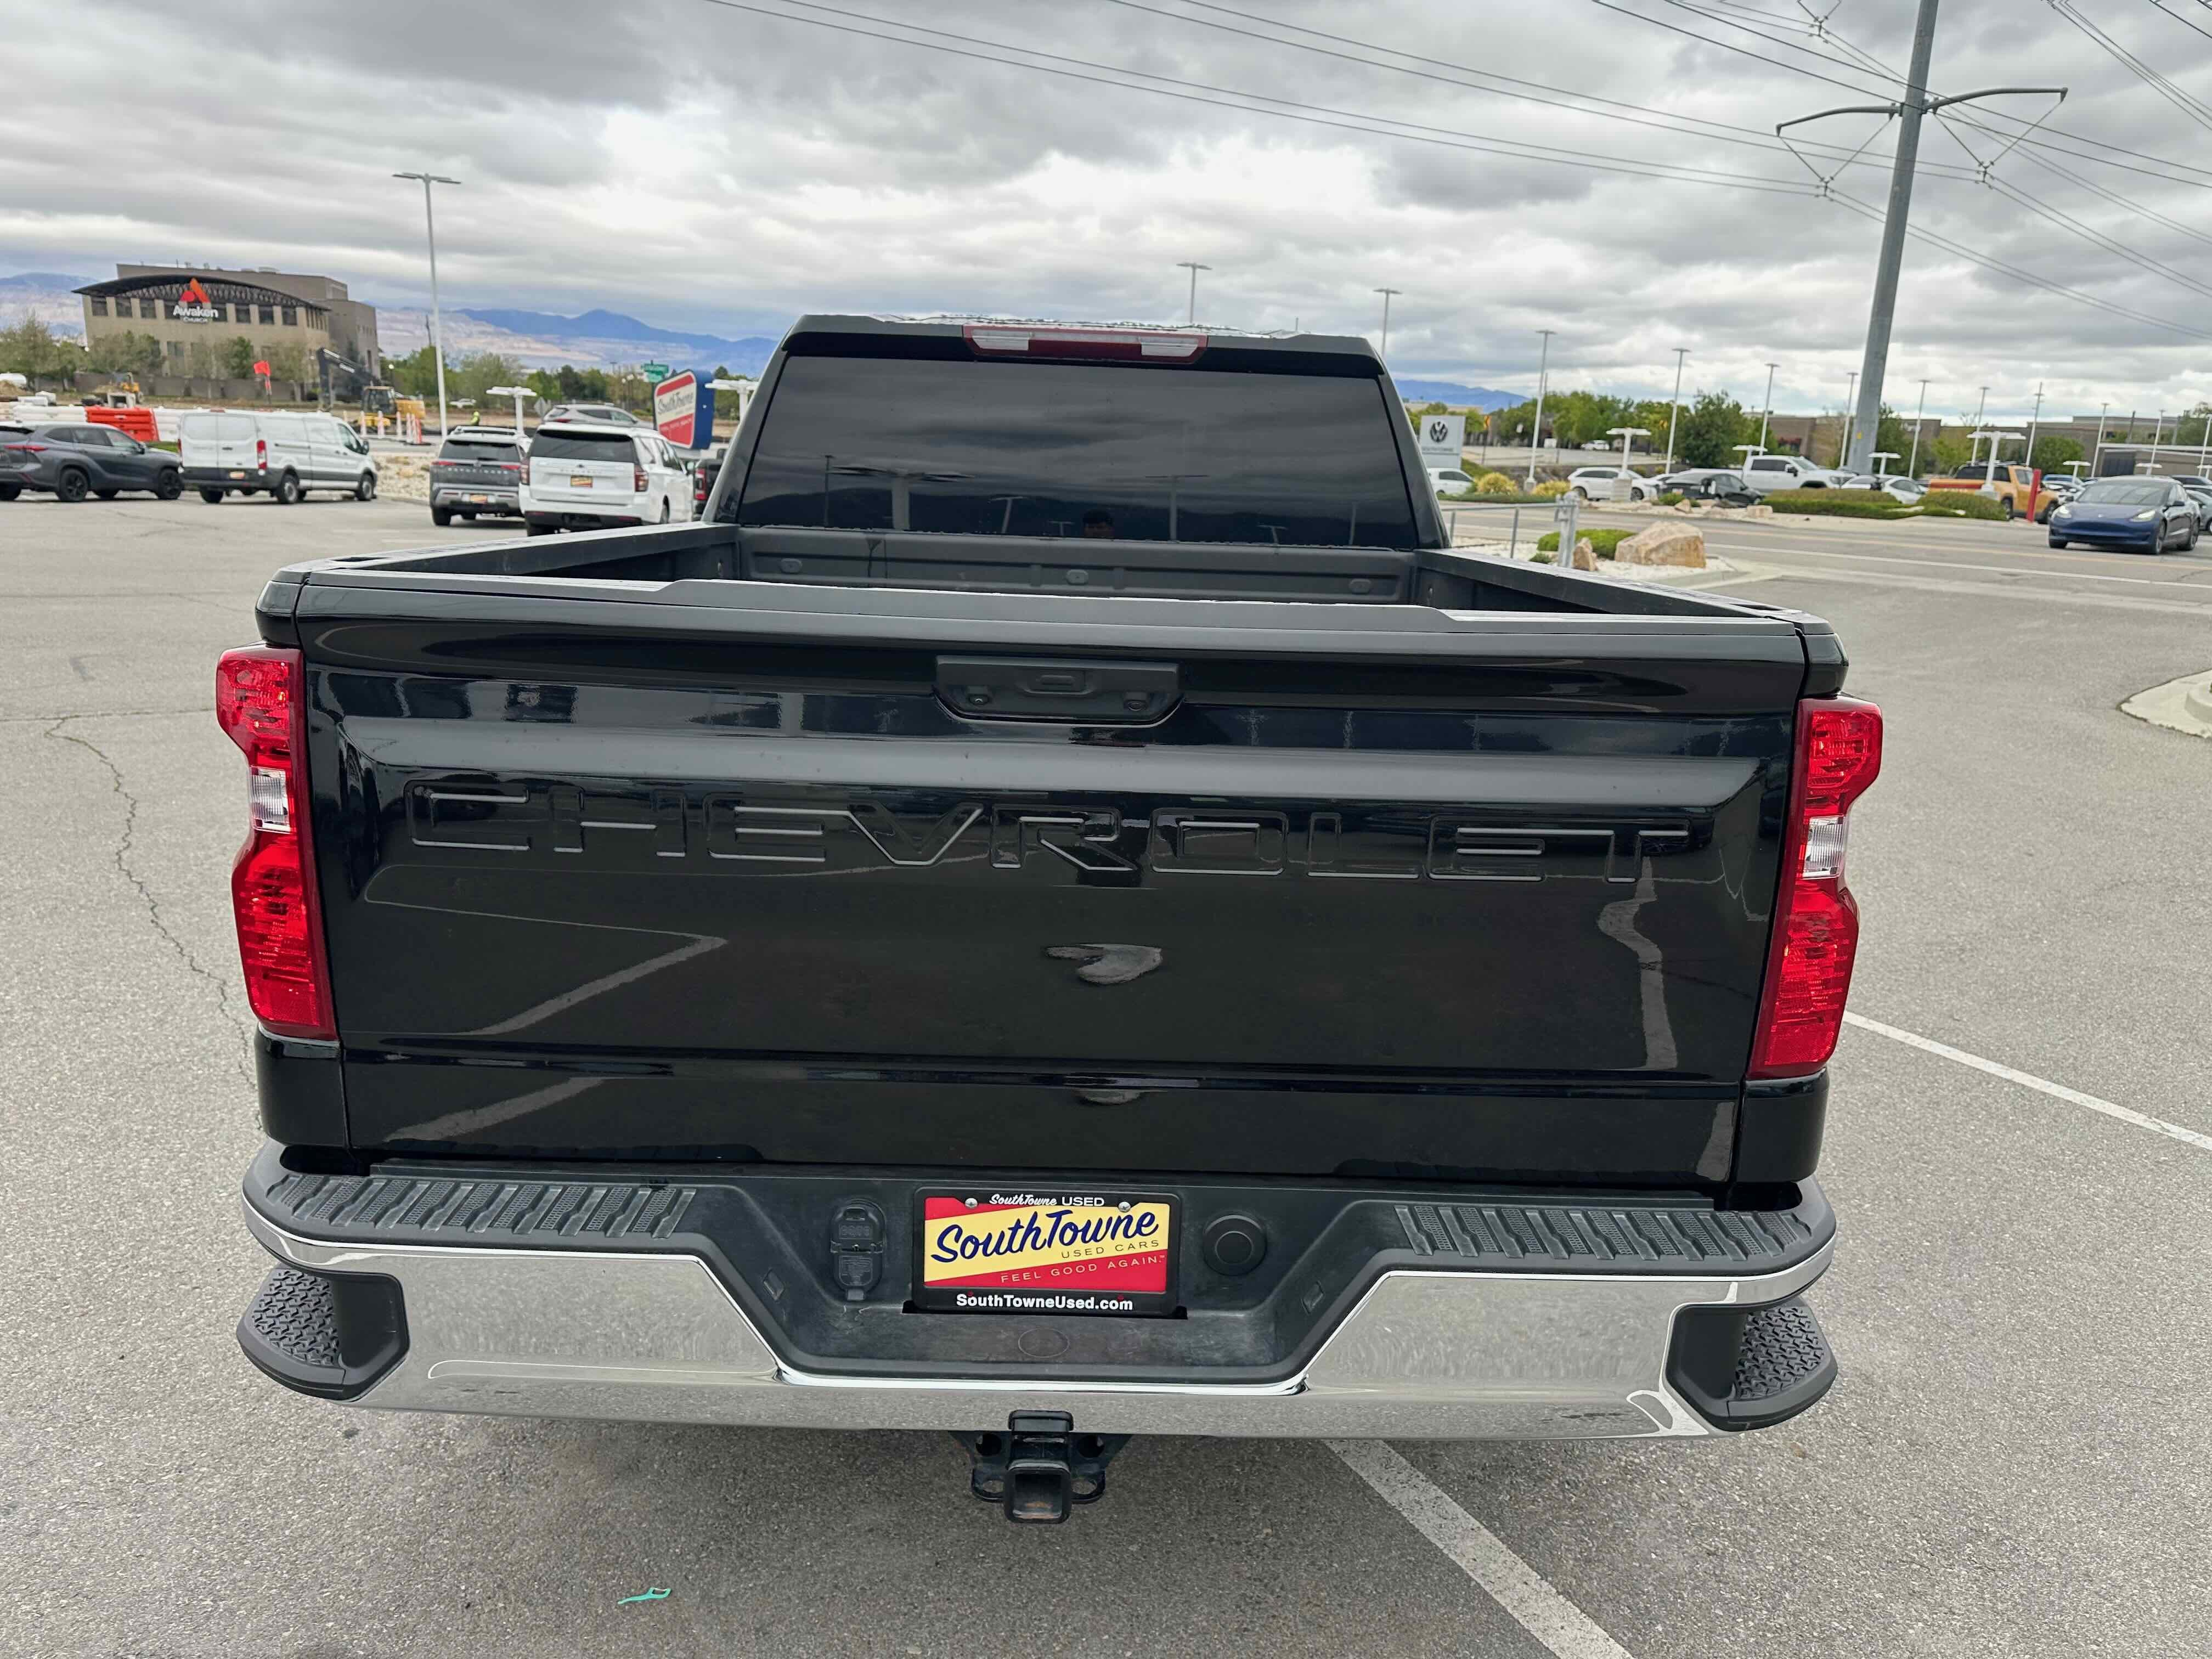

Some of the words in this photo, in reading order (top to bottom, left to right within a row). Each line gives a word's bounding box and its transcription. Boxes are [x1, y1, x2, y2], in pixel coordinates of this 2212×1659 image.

[173, 305, 218, 318] Awaken
[405, 780, 1690, 883] CHEVROLET
[989, 1194, 1057, 1206] SouthTowne
[1062, 1196, 1104, 1206] USED
[931, 1209, 1159, 1263] SouthTowne
[1062, 1247, 1104, 1259] USED
[1115, 1240, 1159, 1252] CARS
[1001, 1272, 1041, 1283] FEEL
[1051, 1263, 1097, 1276] GOOD
[957, 1294, 1133, 1311] SouthTowneUsed.com
